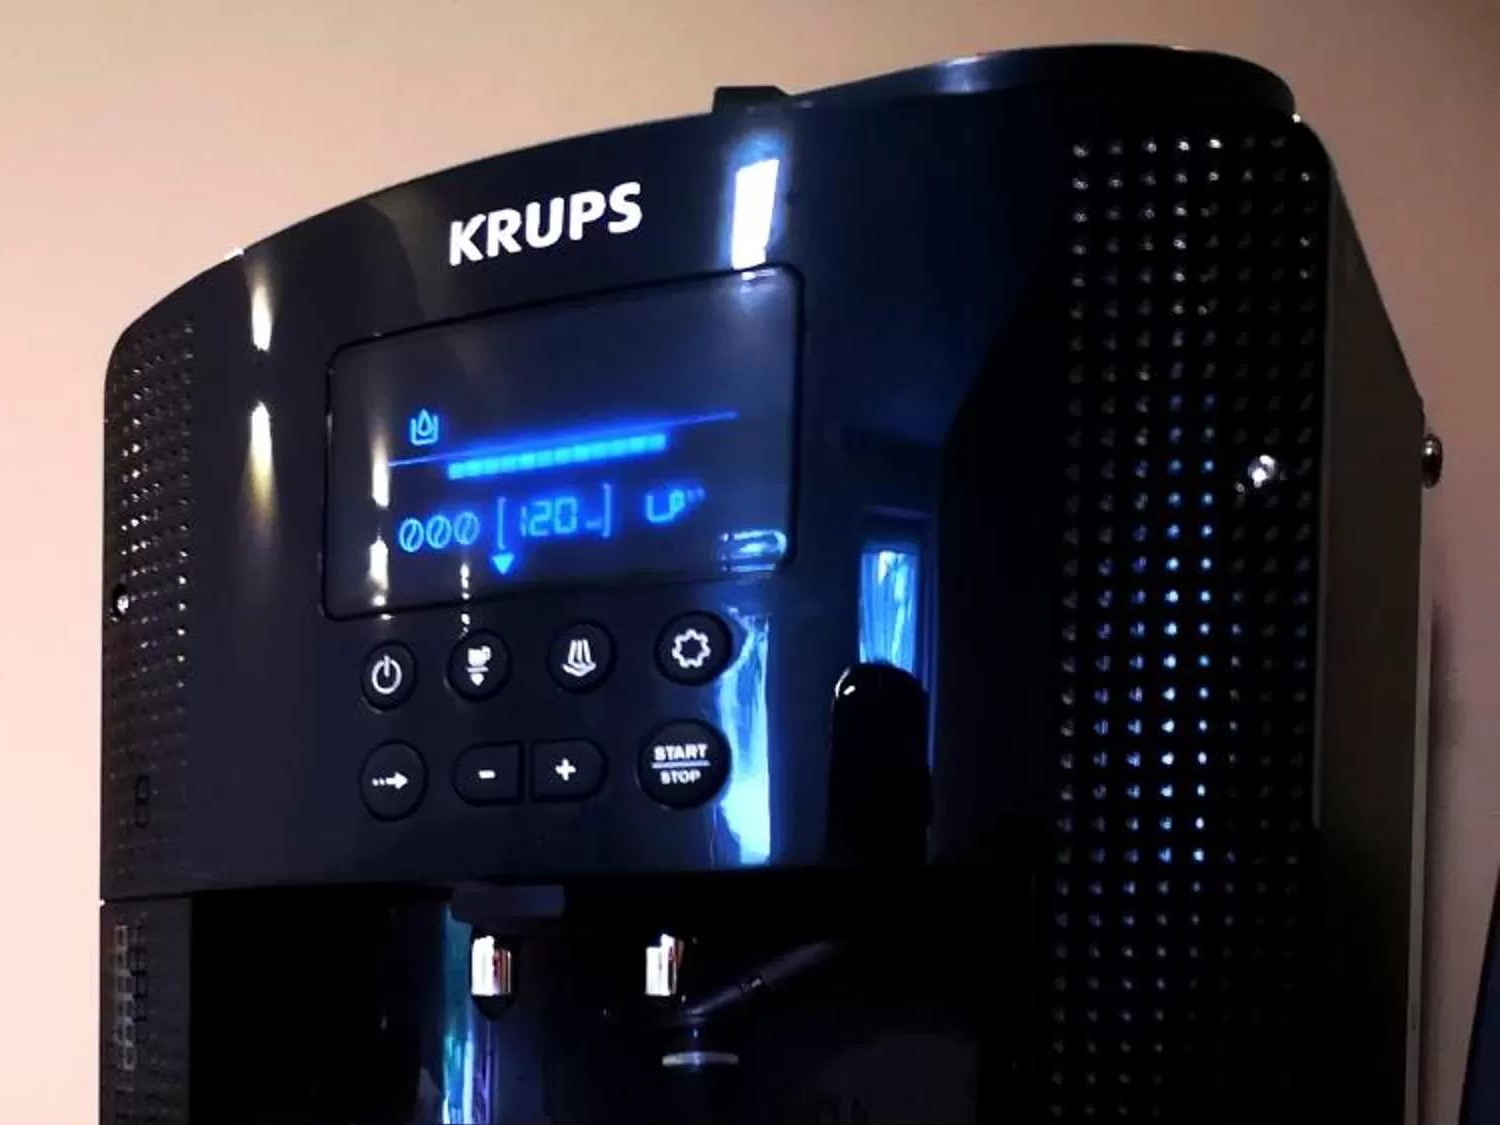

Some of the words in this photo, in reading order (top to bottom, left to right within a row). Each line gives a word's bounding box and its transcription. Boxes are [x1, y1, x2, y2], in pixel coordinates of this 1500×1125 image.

[448, 181, 642, 266] KRUPS
[653, 742, 708, 761] START
[659, 768, 702, 785] STOP
